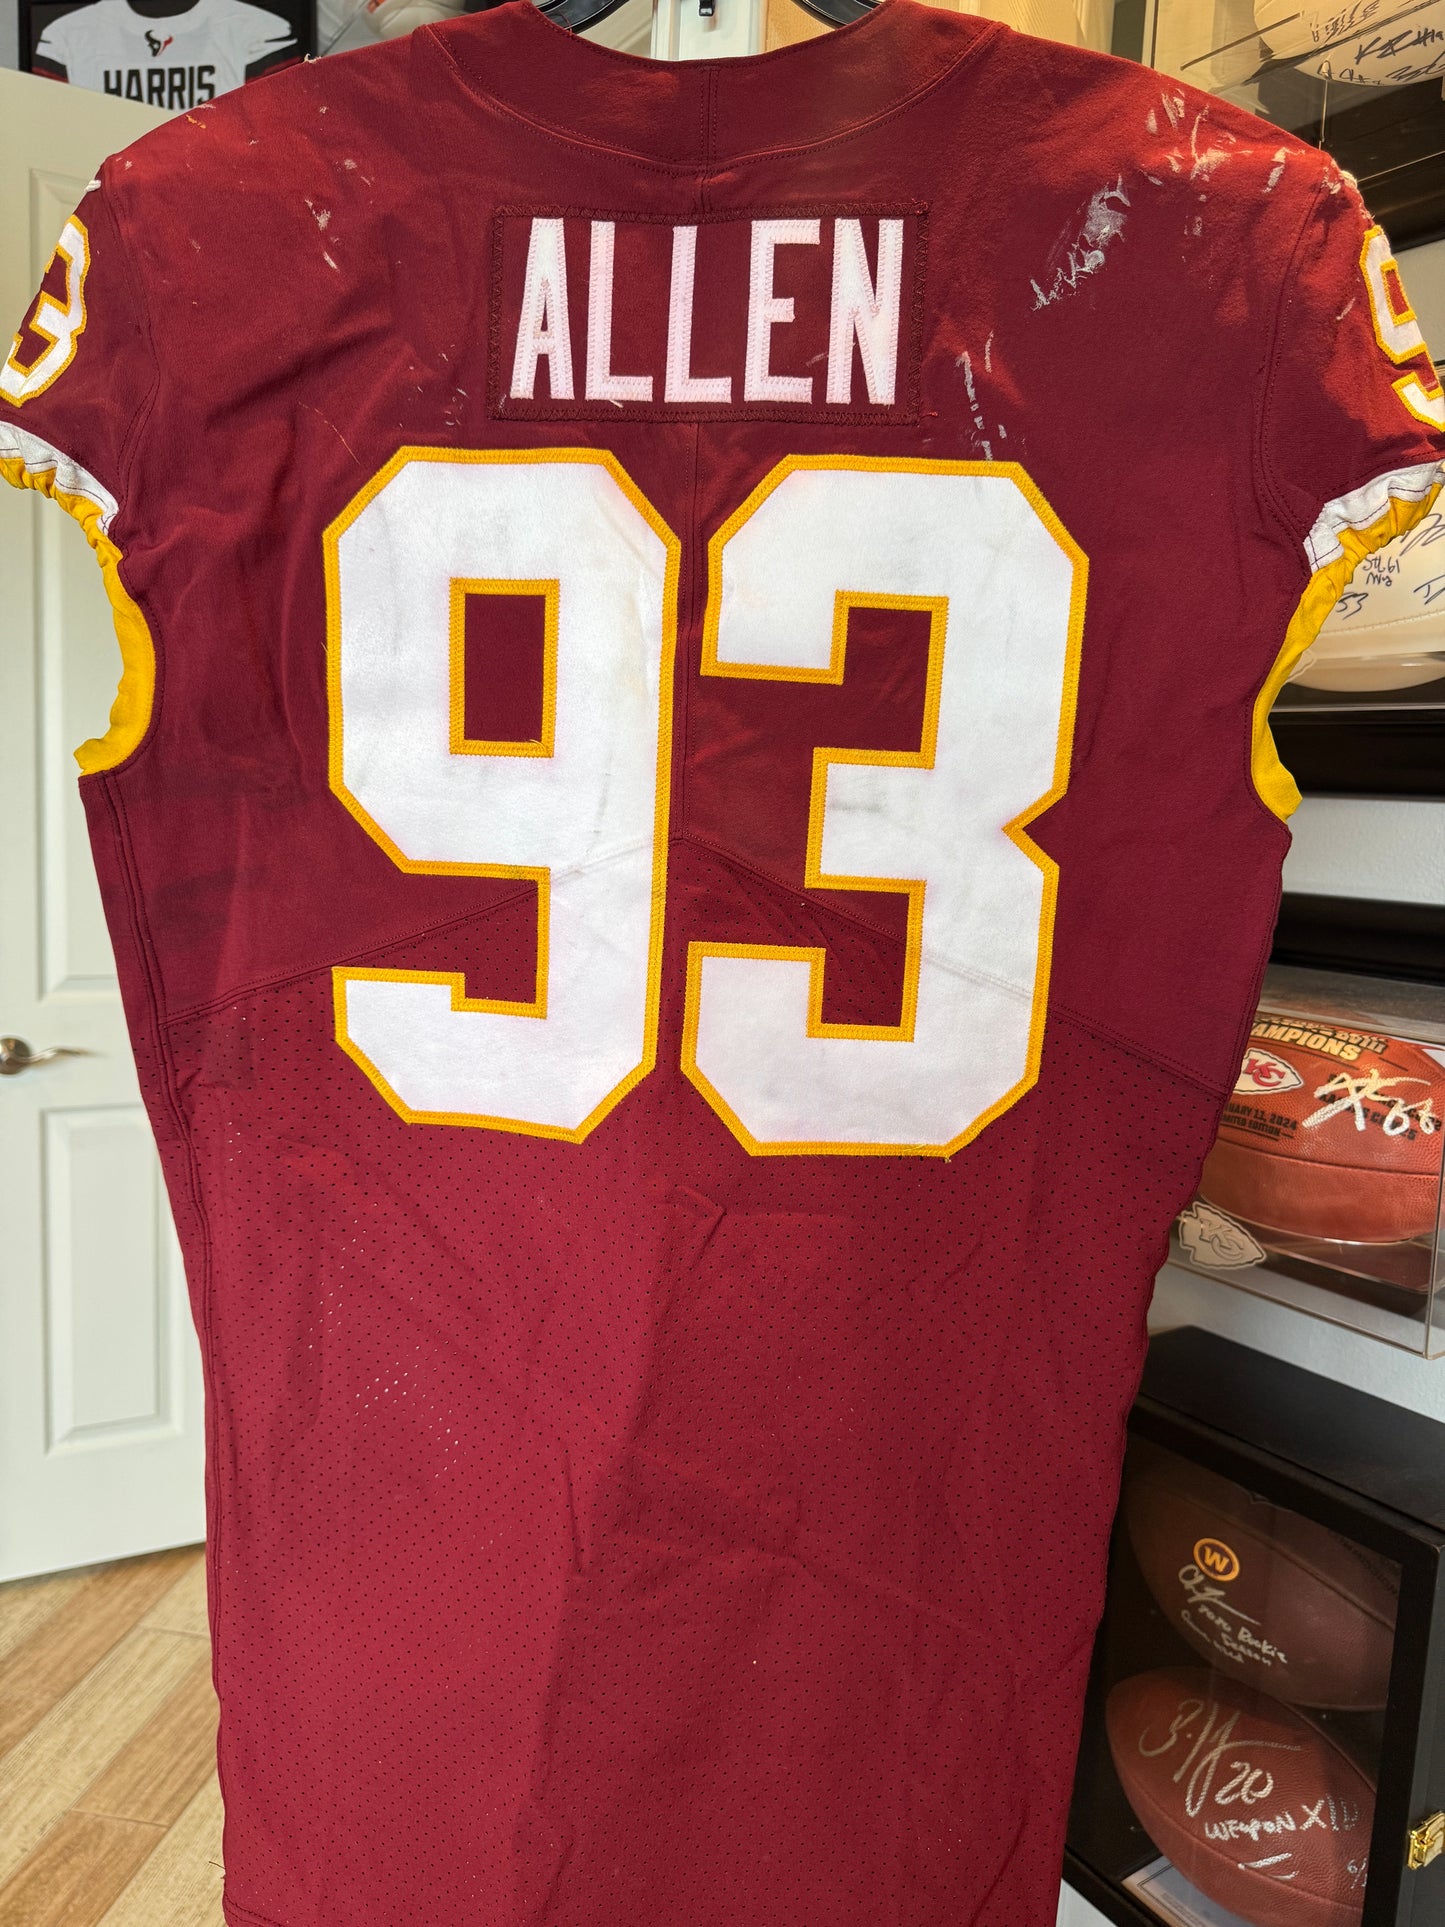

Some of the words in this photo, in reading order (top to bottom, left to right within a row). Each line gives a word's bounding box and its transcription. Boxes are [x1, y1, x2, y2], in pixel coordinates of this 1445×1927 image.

[103, 64, 216, 110] HARRIS
[508, 216, 905, 406] ALLEN
[322, 445, 1090, 1157] 93
[1249, 1020, 1363, 1062] AMPIONS
[1248, 1119, 1281, 1137] EDITION
[1268, 1113, 1298, 1131] 2024
[1202, 1545, 1230, 1573] W
